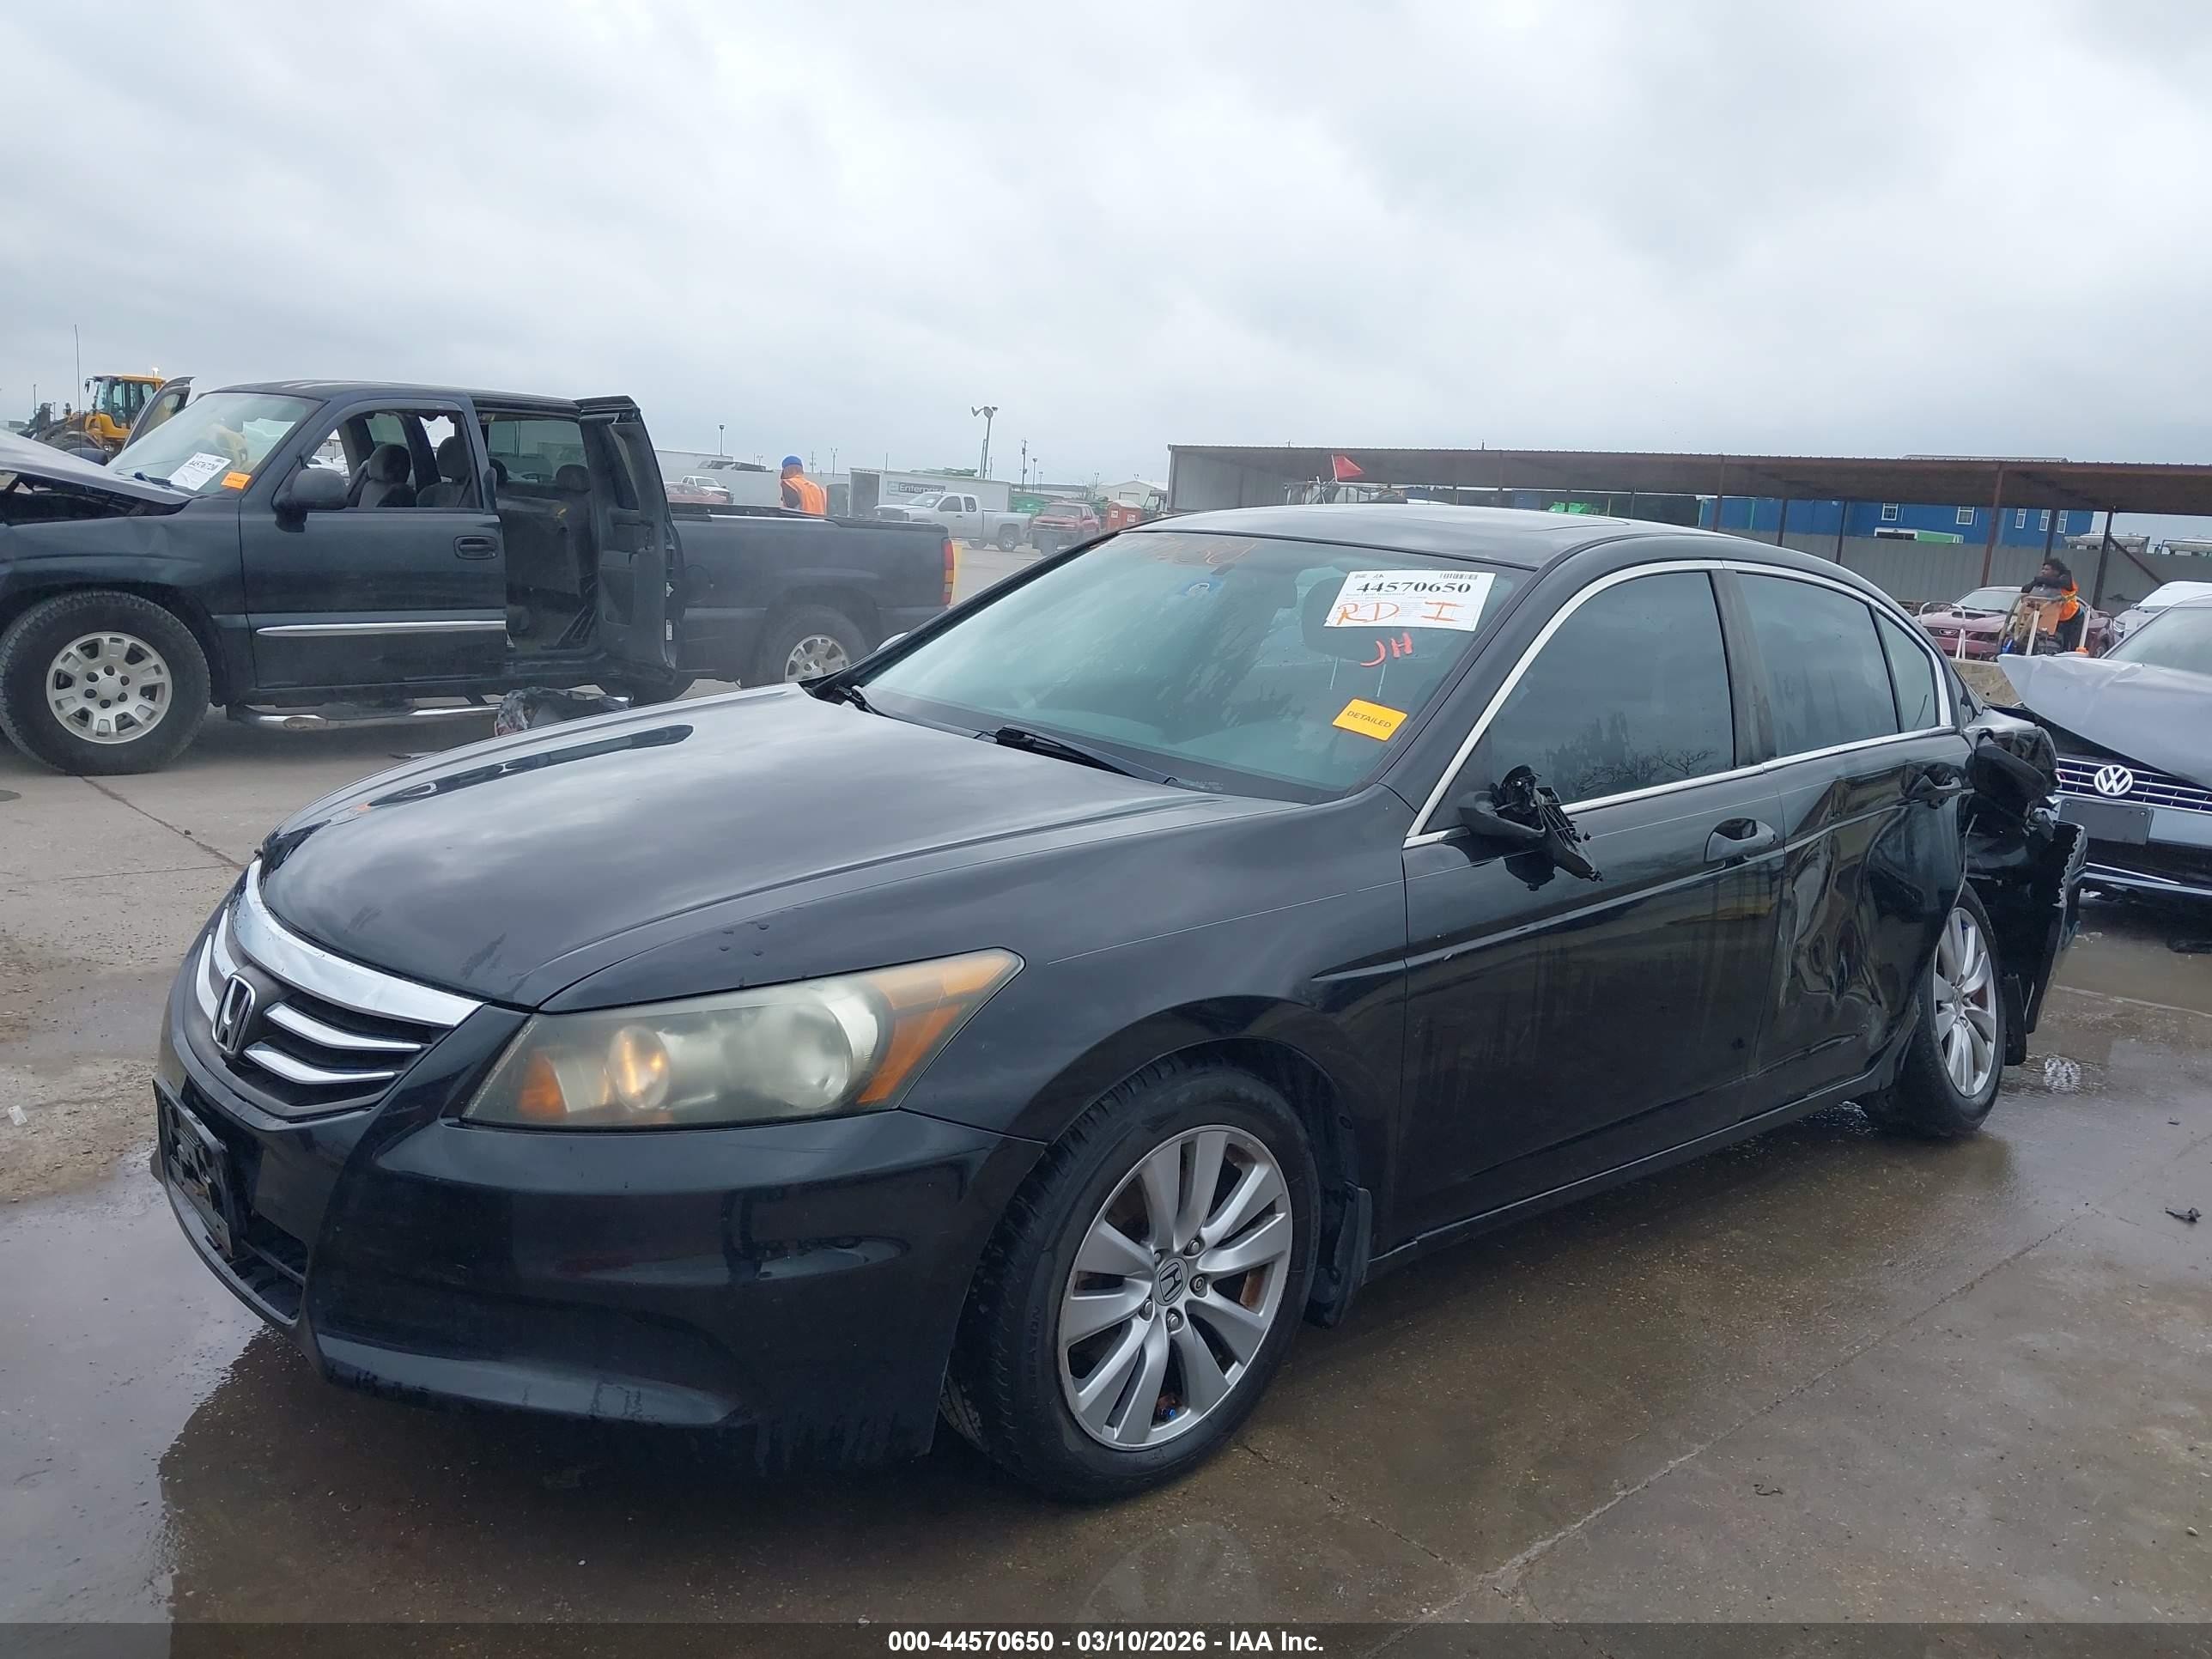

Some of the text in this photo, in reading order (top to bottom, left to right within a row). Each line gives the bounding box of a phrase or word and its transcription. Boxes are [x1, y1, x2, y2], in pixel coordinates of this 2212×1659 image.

[1356, 581, 1472, 593] 44570650
[1360, 631, 1413, 667] JH
[1346, 710, 1392, 728] DETAILED
